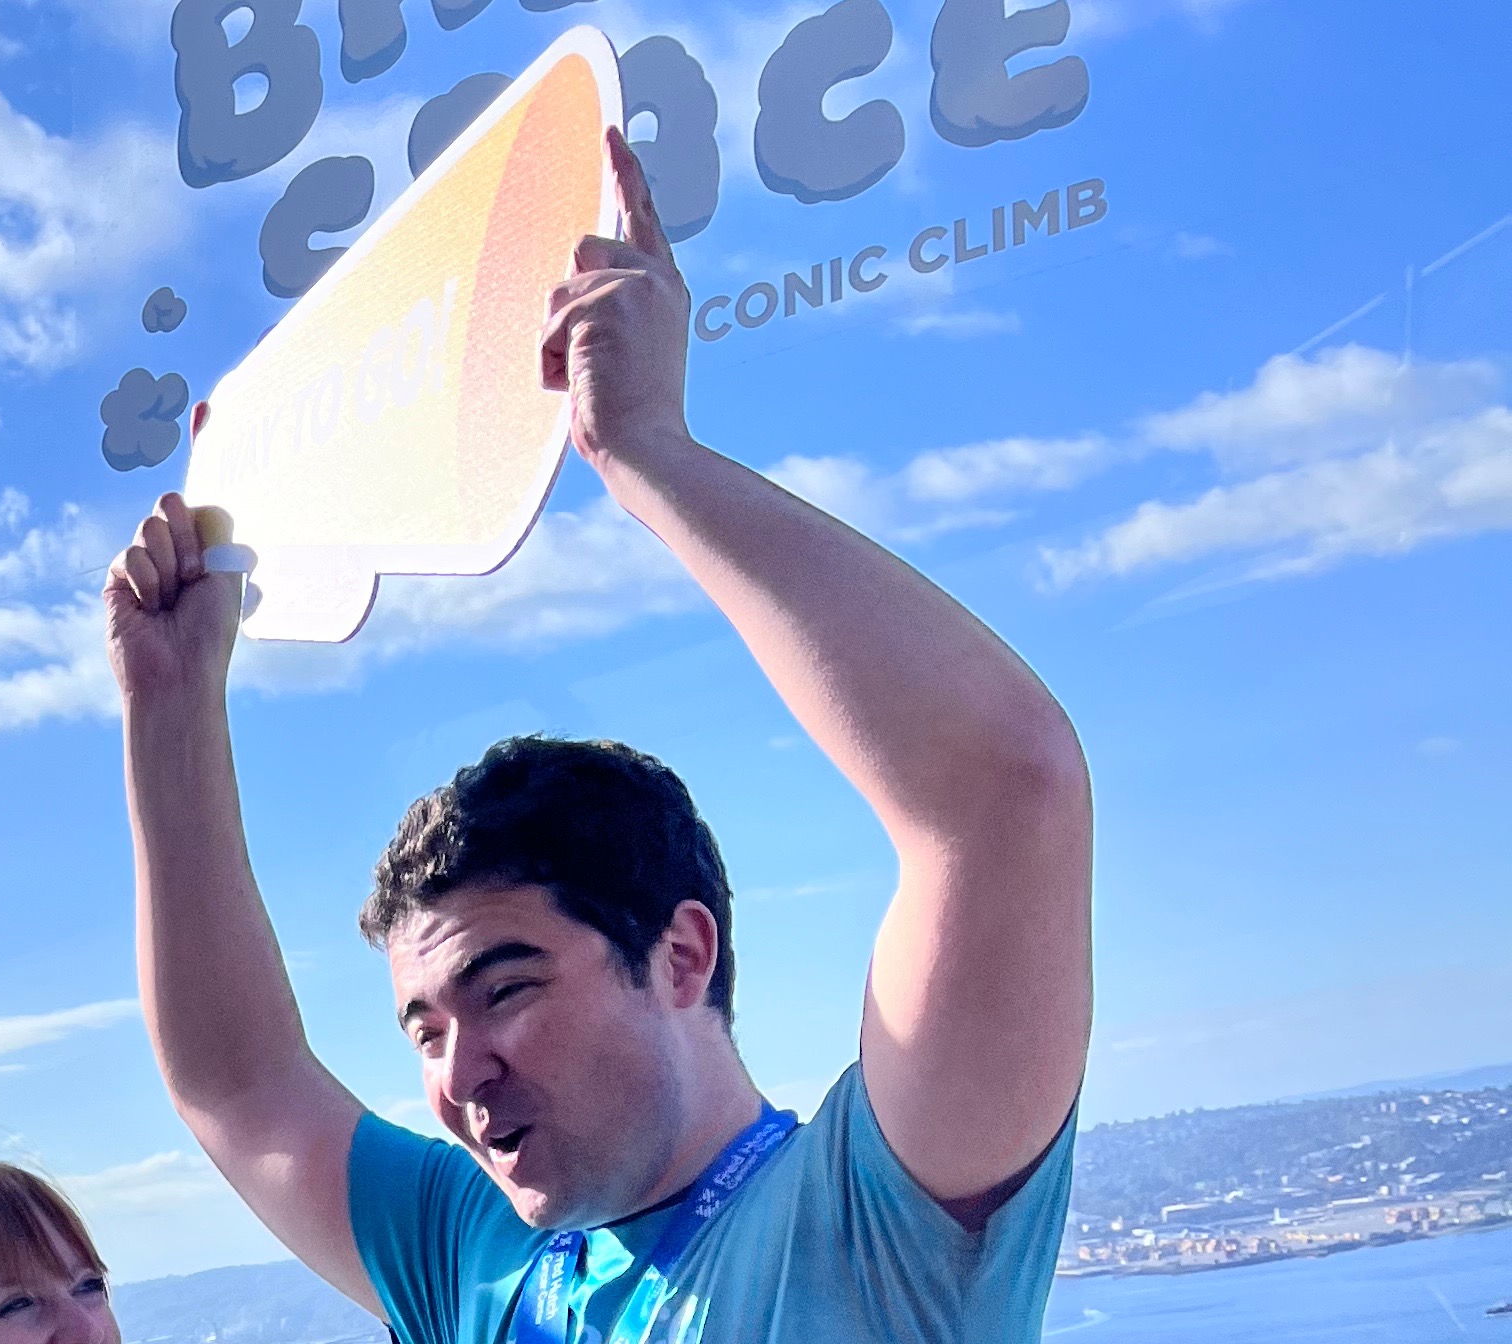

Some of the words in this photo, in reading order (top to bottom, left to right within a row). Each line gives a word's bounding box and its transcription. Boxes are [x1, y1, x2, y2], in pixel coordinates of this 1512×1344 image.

[693, 245, 889, 343] CONIC
[908, 177, 1109, 274] CLIMB
[291, 362, 344, 455] TO
[356, 276, 460, 427] GO!
